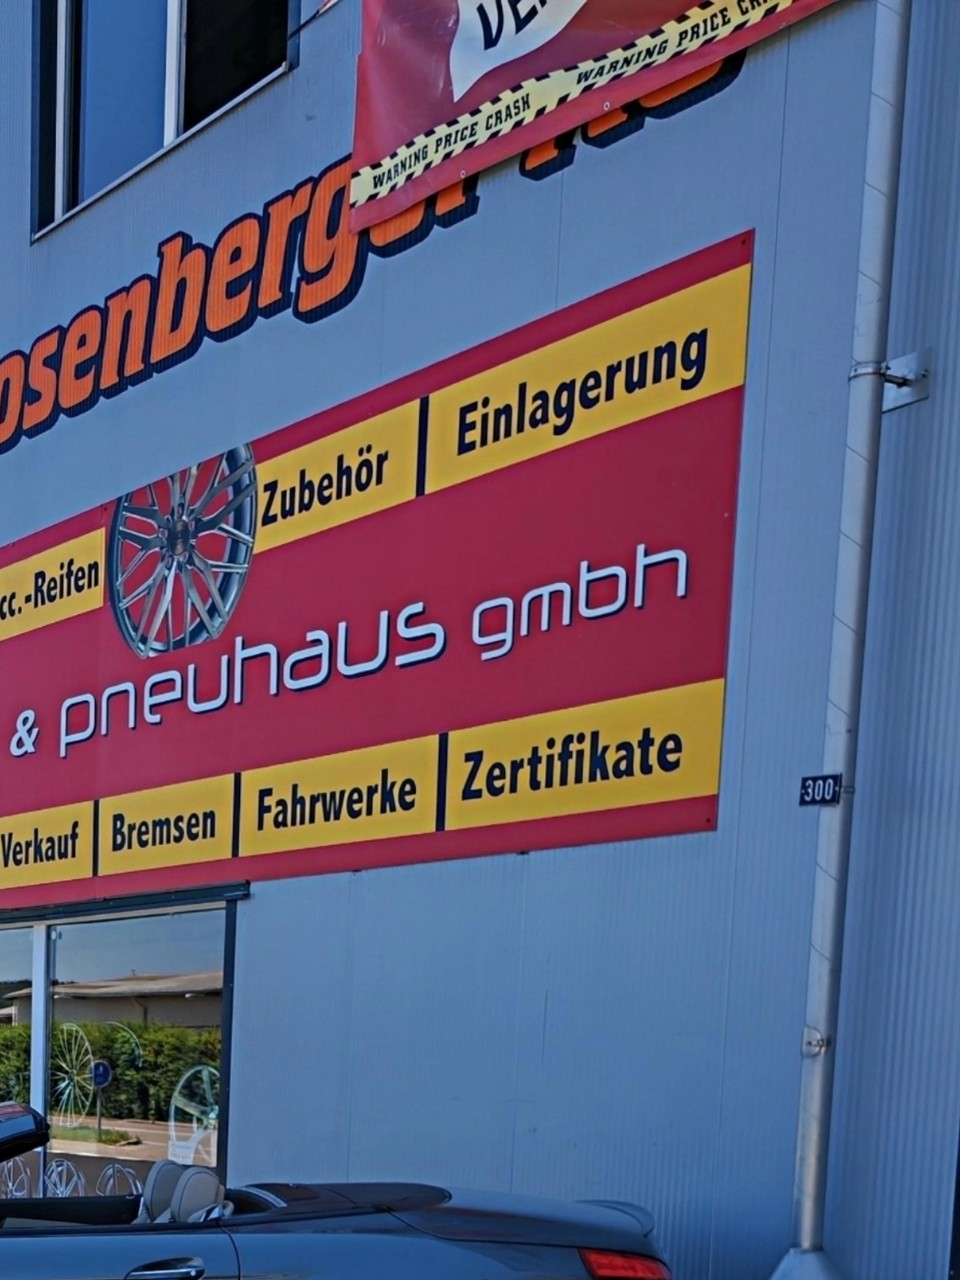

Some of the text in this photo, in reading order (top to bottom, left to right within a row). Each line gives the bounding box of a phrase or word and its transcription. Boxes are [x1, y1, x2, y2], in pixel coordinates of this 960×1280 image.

[372, 144, 429, 190] WARNING
[434, 121, 478, 154] PRICE
[485, 93, 531, 131] CRASH
[576, 38, 669, 85] WARNING
[676, 7, 732, 48] PRICE
[456, 327, 709, 456] Einlagerung
[261, 444, 389, 527] Zubehör
[9, 709, 39, 758] &
[59, 600, 446, 757] pneuhaus
[471, 542, 688, 661] gmbh
[256, 769, 417, 832] Fahrwerke
[460, 727, 683, 801] Zertifikate
[111, 804, 216, 853] Bremsen
